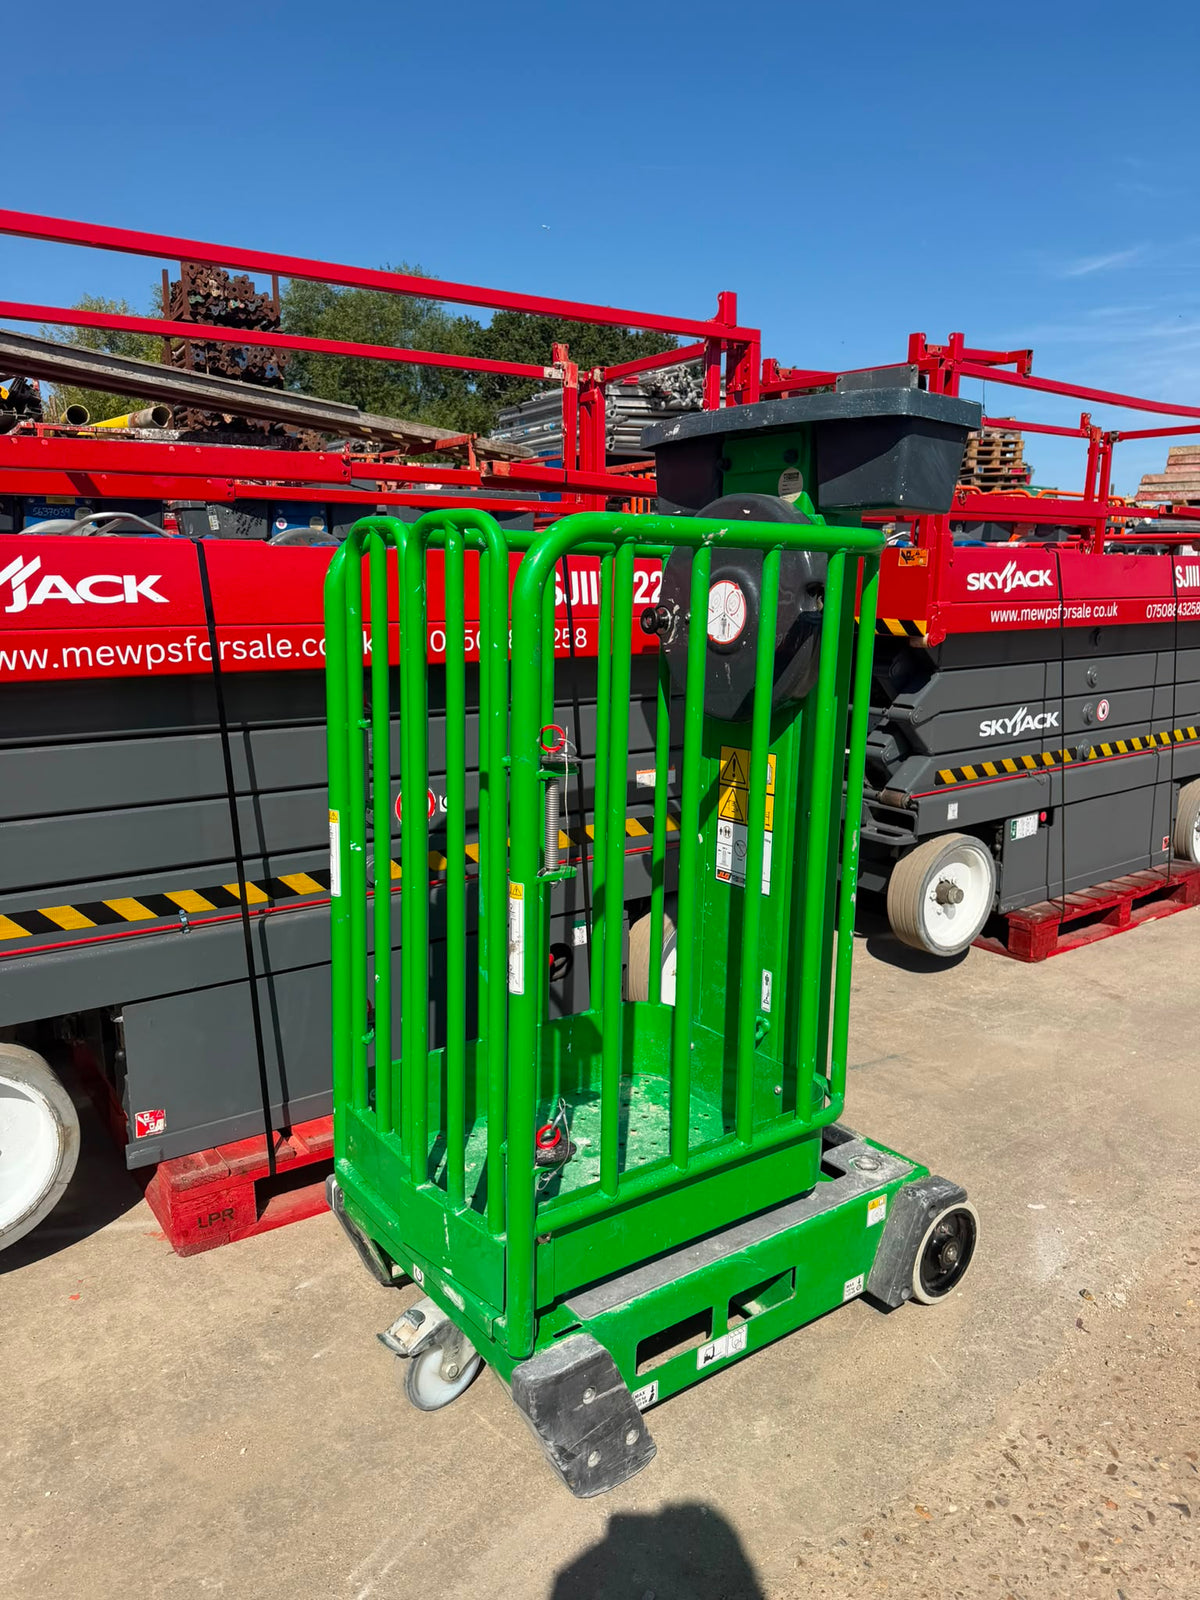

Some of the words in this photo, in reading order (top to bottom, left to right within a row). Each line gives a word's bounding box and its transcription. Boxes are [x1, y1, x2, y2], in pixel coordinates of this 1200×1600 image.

[966, 560, 1053, 593] SKYJACK
[979, 706, 1059, 737] SKYJACK
[198, 1207, 234, 1229] LPR
